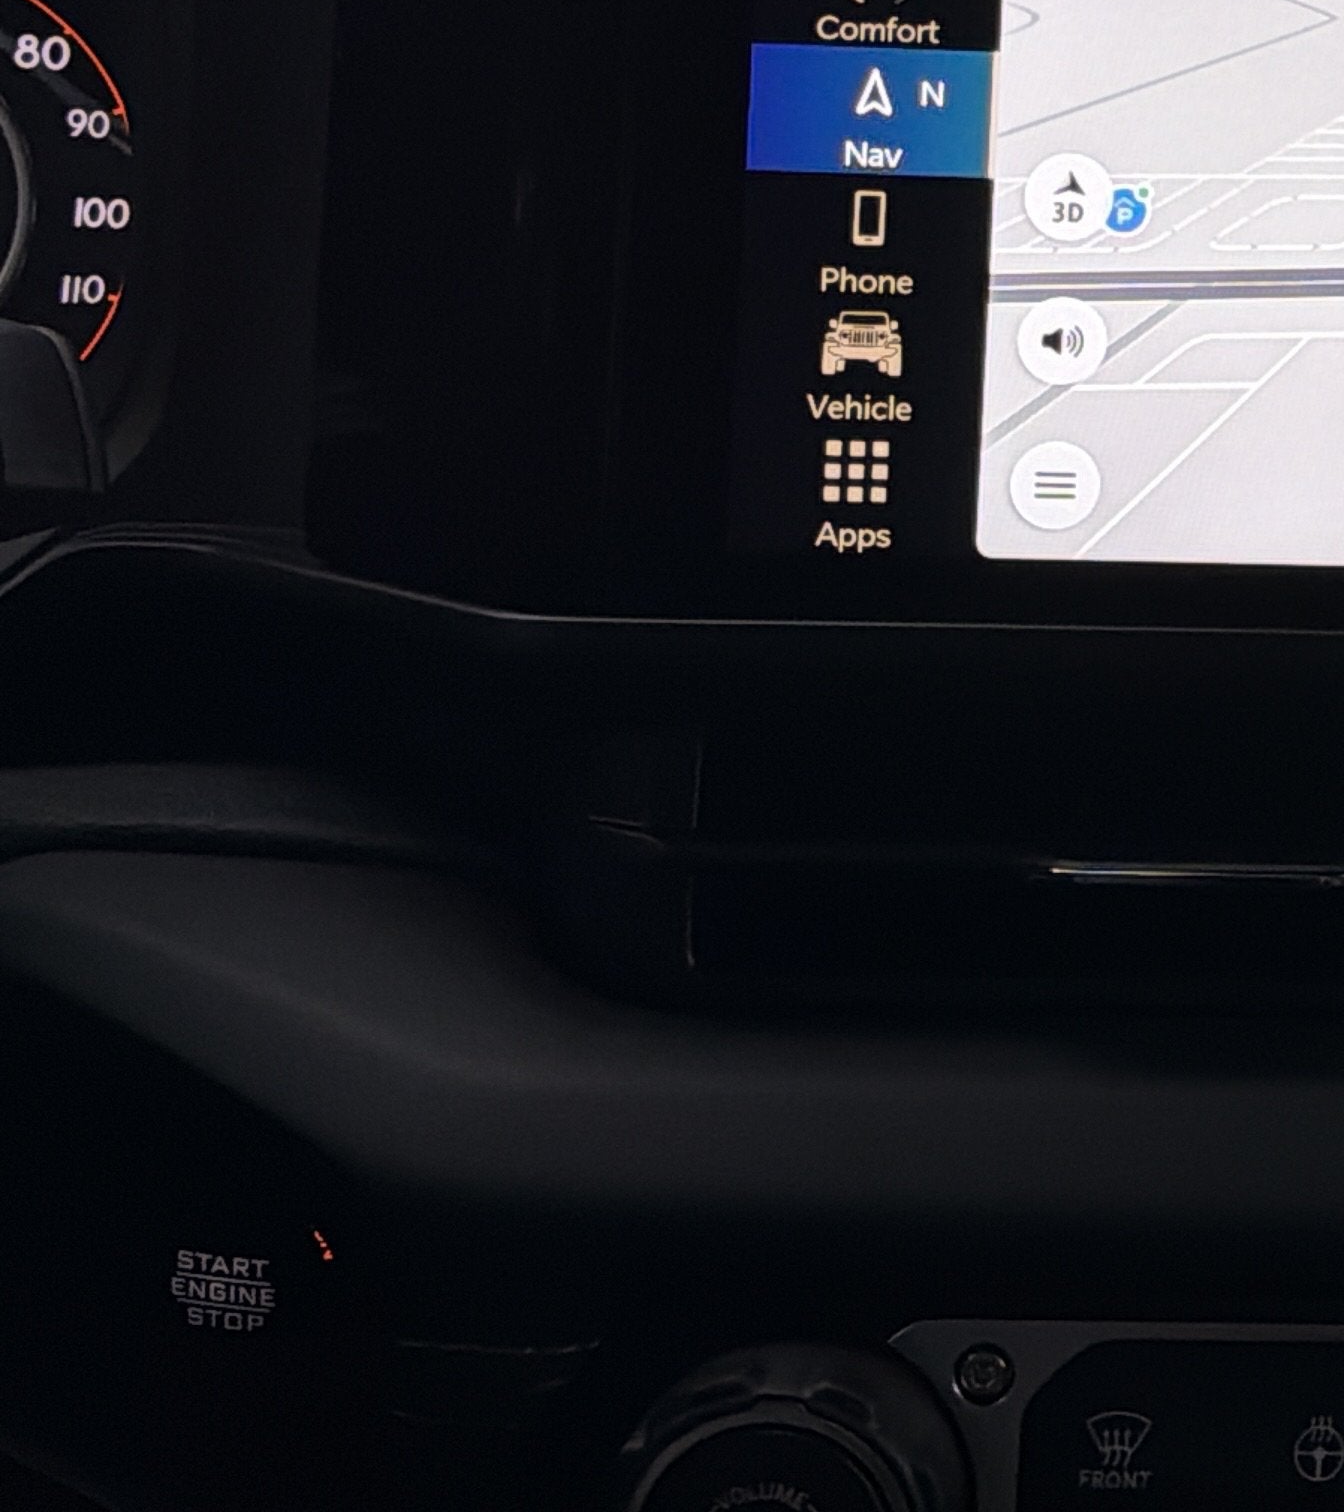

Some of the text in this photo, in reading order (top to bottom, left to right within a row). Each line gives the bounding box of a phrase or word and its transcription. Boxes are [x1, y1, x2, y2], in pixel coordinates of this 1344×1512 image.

[816, 15, 940, 45] Comfort
[14, 34, 71, 71] 80
[920, 81, 945, 108] N
[67, 109, 110, 139] 90
[844, 140, 903, 169] Nav
[74, 197, 130, 230] 100
[1052, 202, 1083, 224] 3D
[60, 275, 105, 304] 110
[820, 267, 914, 295] Phone
[806, 393, 912, 421] Vehicle
[815, 522, 892, 552] Apps
[177, 1249, 270, 1278] START
[171, 1277, 276, 1307] ENGINE
[187, 1307, 264, 1332] STOP
[1080, 1469, 1152, 1491] FRONT
[713, 1482, 810, 1510] VOLUME
